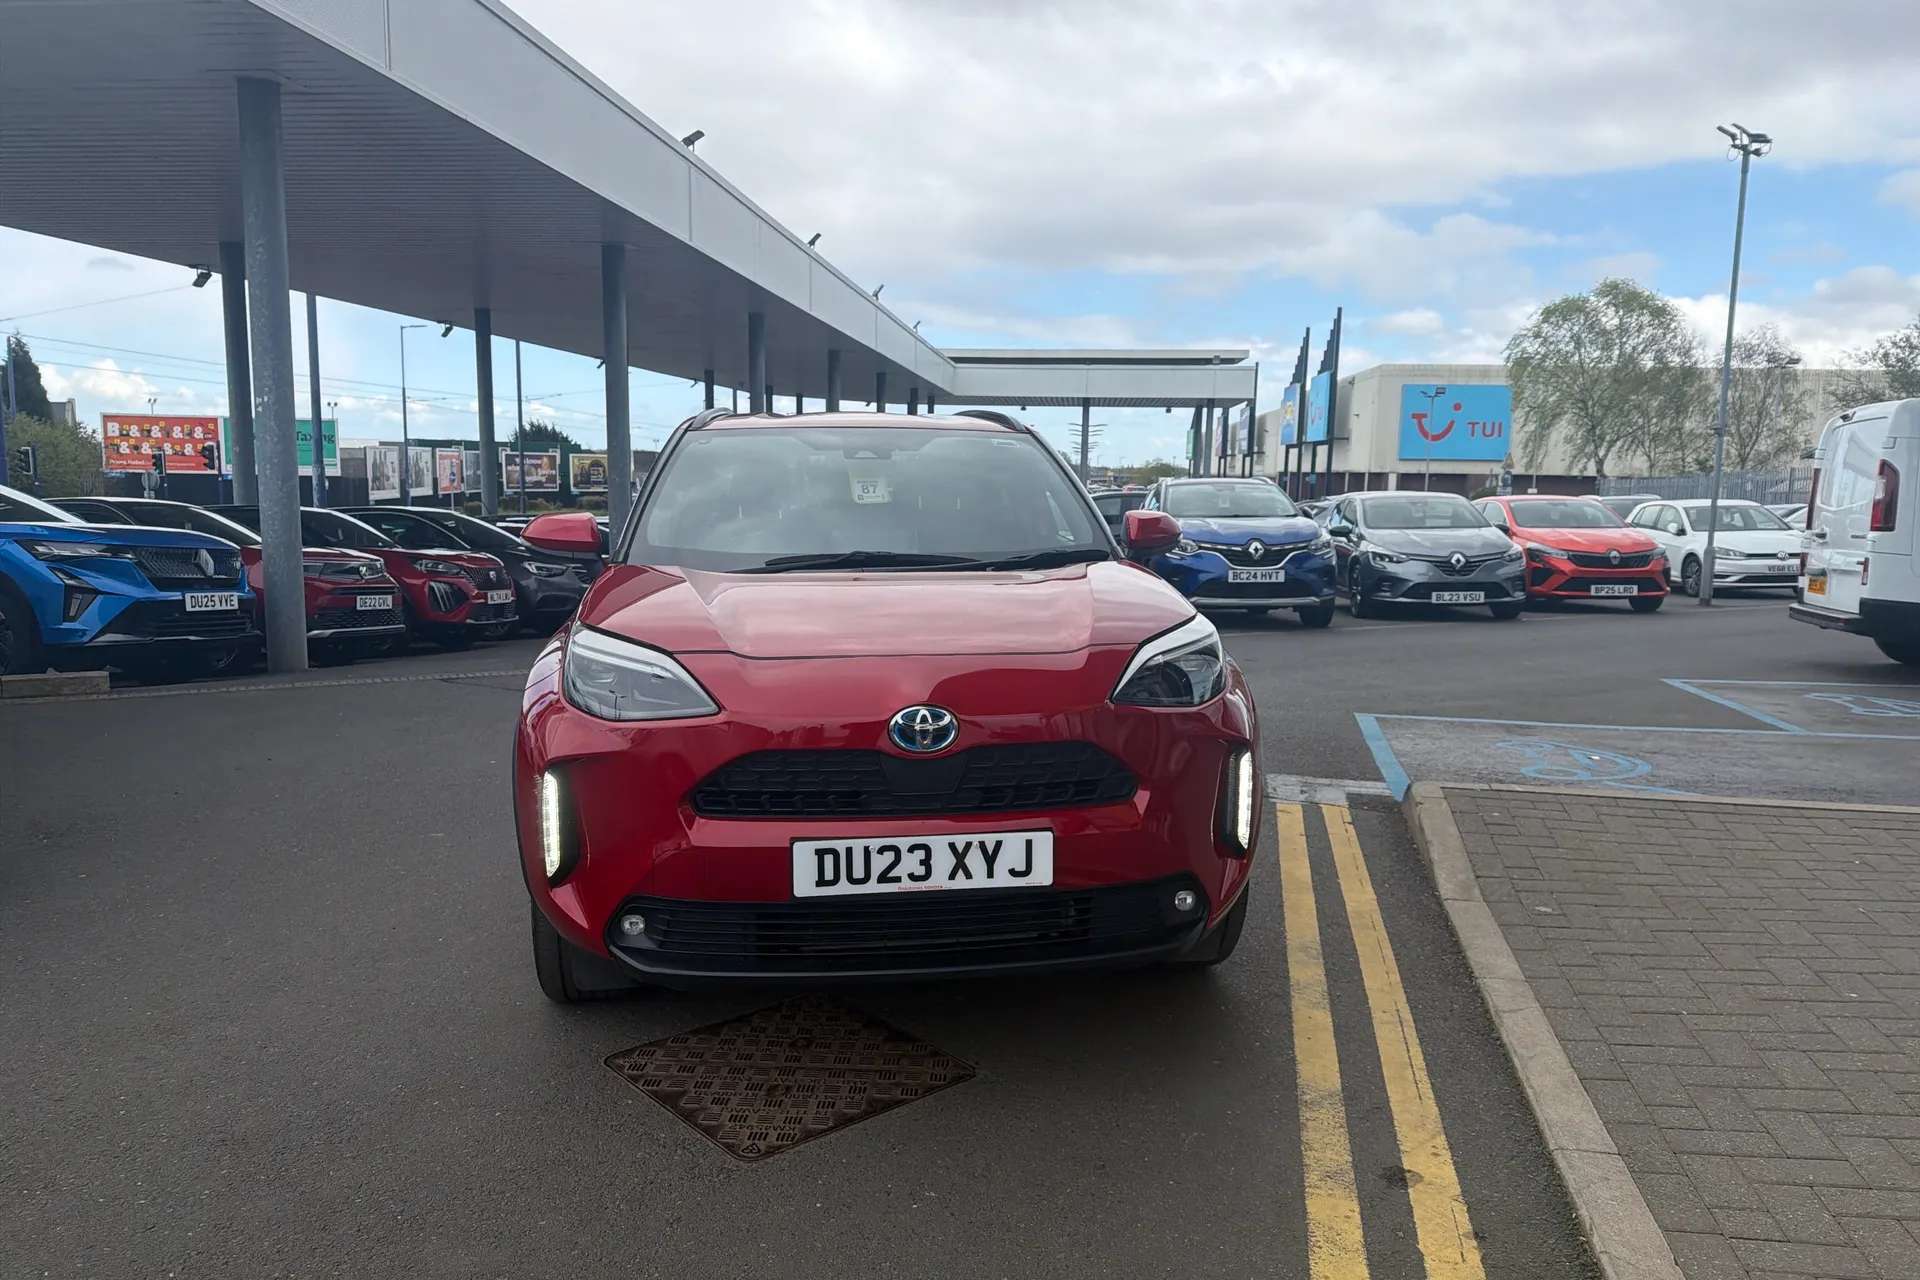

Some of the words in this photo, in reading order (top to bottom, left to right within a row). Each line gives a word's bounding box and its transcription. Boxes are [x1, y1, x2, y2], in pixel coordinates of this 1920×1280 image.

[1467, 421, 1503, 438] TUI
[1232, 571, 1258, 581] BC24
[1261, 571, 1280, 581] HVT
[190, 594, 216, 608] DU25
[359, 597, 377, 608] DE22
[1435, 593, 1460, 602] BL23
[1463, 593, 1481, 602] VSU
[814, 843, 933, 888] DU23
[948, 838, 1033, 881] XYJ
